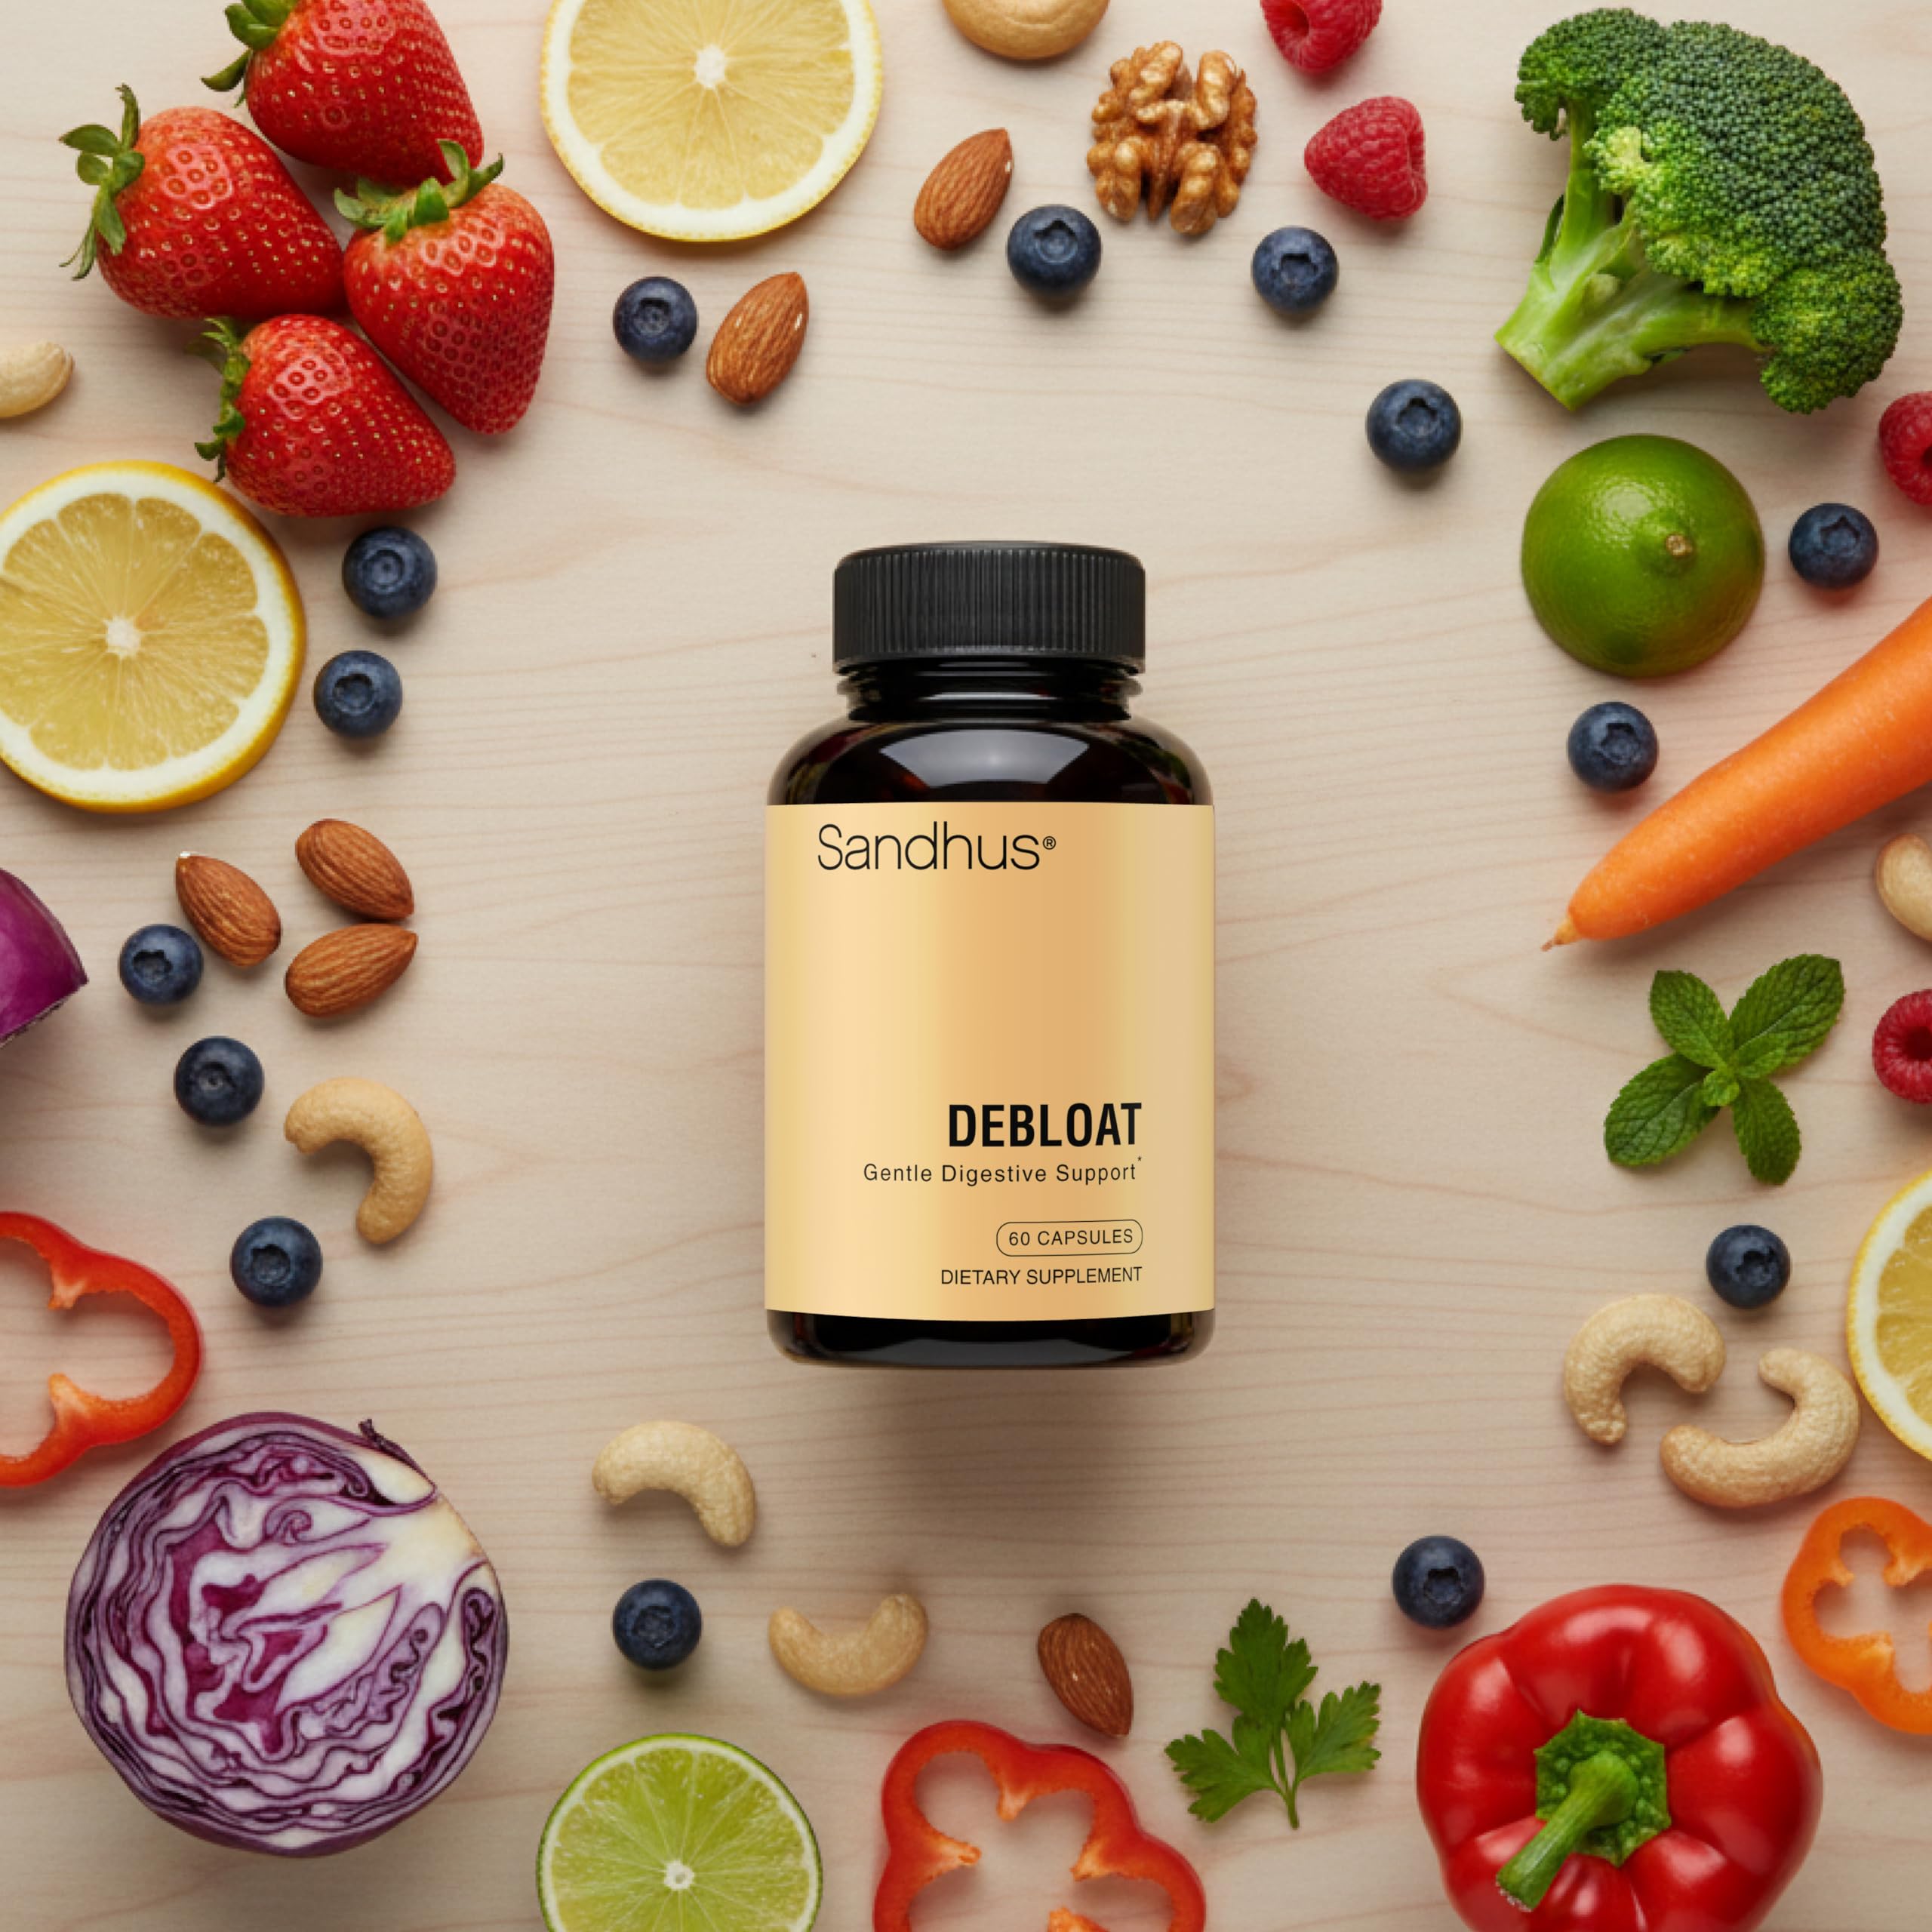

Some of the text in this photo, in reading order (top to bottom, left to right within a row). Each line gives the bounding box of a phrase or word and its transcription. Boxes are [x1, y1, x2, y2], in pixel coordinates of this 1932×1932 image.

[949, 1102, 1143, 1148] DEBLOAT
[863, 1163, 932, 1183] Gentle
[942, 1164, 1047, 1187] Digestive
[1008, 1228, 1134, 1247] 60 CAPSULES
[941, 1266, 1143, 1285] DIETARY SUPPLEMENT
